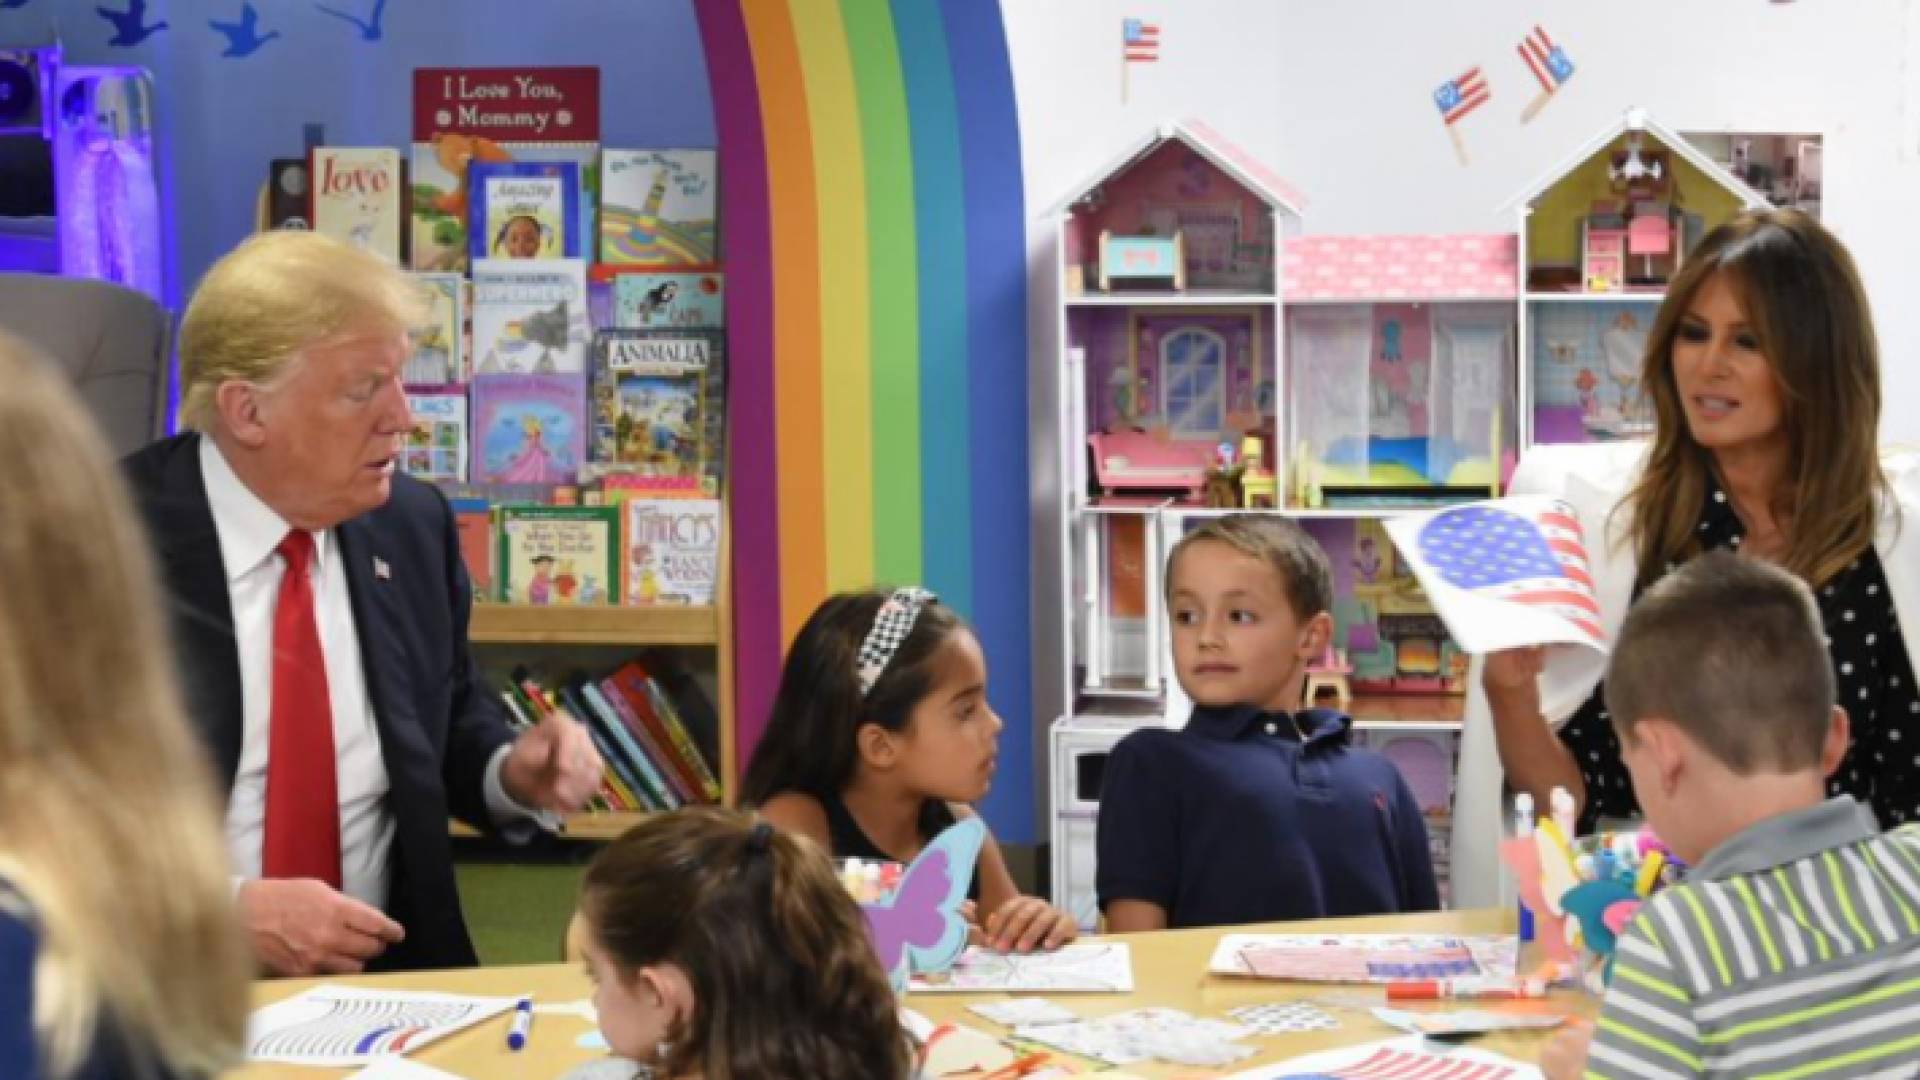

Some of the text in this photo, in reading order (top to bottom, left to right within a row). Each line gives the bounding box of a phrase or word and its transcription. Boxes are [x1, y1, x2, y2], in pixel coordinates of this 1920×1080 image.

[445, 75, 564, 102] I Love You,
[458, 104, 550, 133] Mommy
[321, 156, 389, 195] love
[613, 342, 707, 366] ANIMALIA
